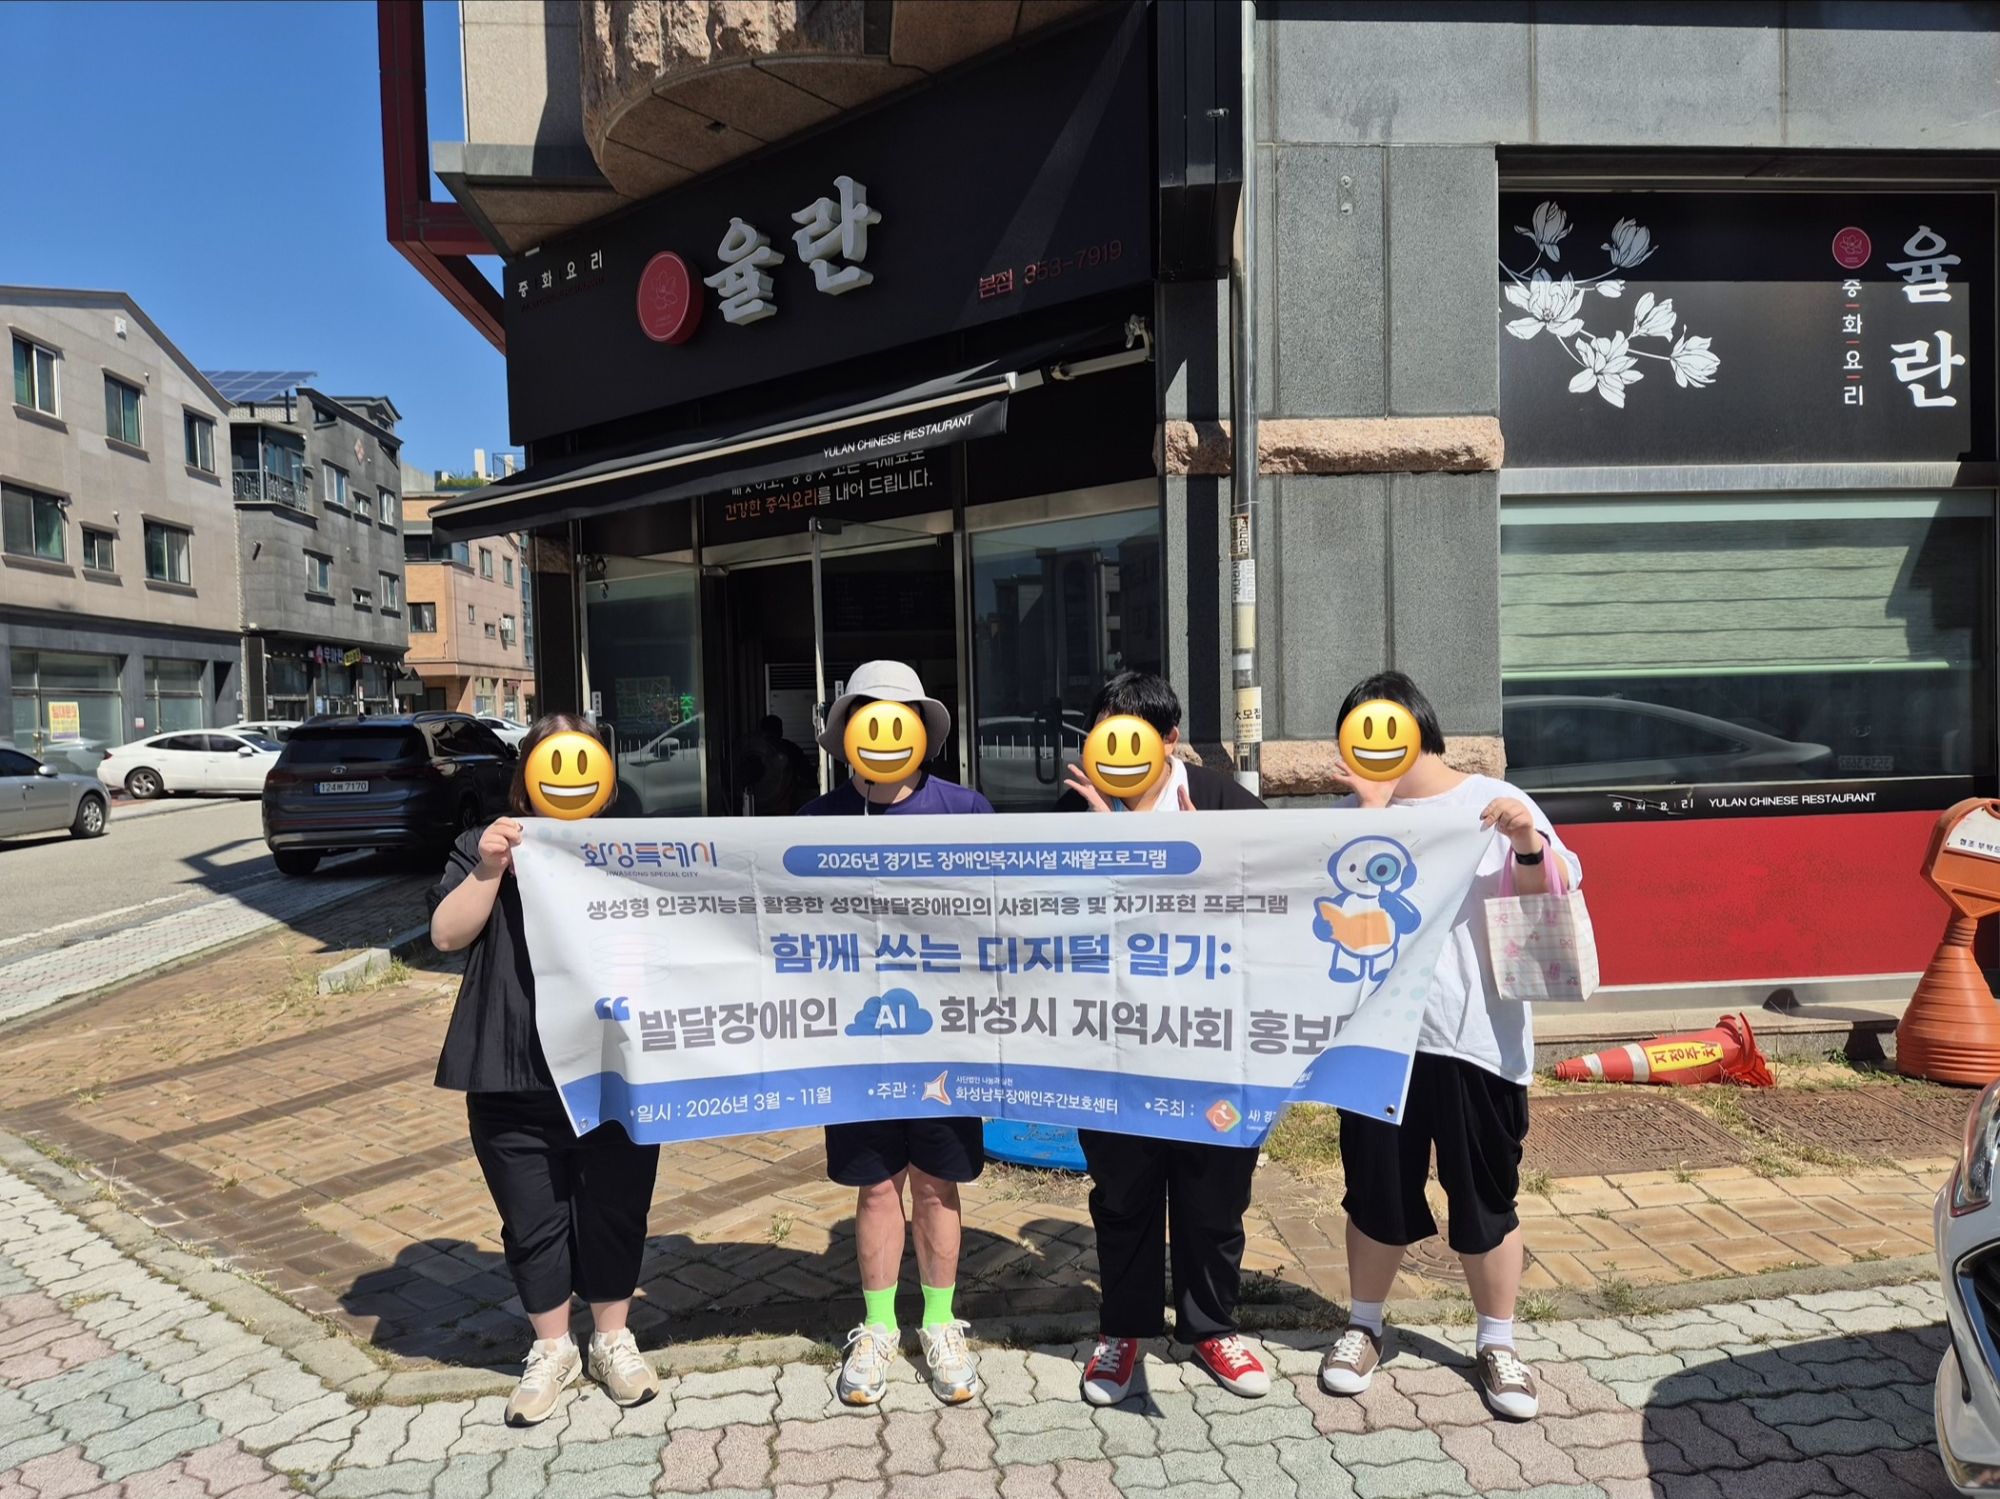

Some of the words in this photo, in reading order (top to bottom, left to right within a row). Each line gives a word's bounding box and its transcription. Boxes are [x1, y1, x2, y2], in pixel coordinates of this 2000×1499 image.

[704, 175, 882, 326] 율란
[979, 268, 1014, 299] 본점
[1024, 239, 1122, 285] 353-7919
[1886, 225, 1966, 408] 율란
[823, 441, 855, 459] YULAN
[857, 432, 901, 451] CHINESE
[903, 413, 974, 442] RESTAURANT
[725, 499, 761, 522] 건강한
[765, 485, 831, 514] 중식요리를
[836, 479, 864, 502] 내어
[869, 468, 933, 496] 드립니다.
[345, 782, 367, 791] 7170
[1709, 798, 1747, 808] YULAN
[1749, 796, 1798, 807] CHINESE
[1802, 793, 1877, 805] RESTAURANT
[580, 842, 718, 868] 화성특례시
[817, 852, 879, 871] 2026년
[884, 851, 934, 870] 경기도
[937, 850, 1057, 870] 장애인복지시설
[1061, 849, 1167, 869] 재활프로그램
[587, 897, 650, 920] 생성형
[656, 896, 758, 917] 인공지능을
[763, 896, 824, 915] 활용한
[830, 896, 992, 916] 성인발달장애인의
[999, 896, 1080, 917] 사회적응
[1087, 896, 1107, 914] 및
[1113, 895, 1197, 915] 자기표현
[1203, 894, 1289, 915] 프로그램
[770, 932, 860, 973] 함께
[875, 933, 962, 973] 쓰는
[978, 933, 1110, 974] 디지털
[1127, 933, 1232, 980] 일기:
[874, 1004, 907, 1029] AI
[940, 996, 1058, 1038] 화성시
[1072, 998, 1233, 1051] 지역사회
[637, 1102, 672, 1123] 일시
[686, 1095, 748, 1118] 2026년
[753, 1091, 781, 1112] 3월
[800, 1086, 832, 1105] 11월
[877, 1082, 908, 1099] 주관
[955, 1085, 1119, 1115] 화성남부장애인주간보호센터
[1153, 1098, 1185, 1118] 주최
